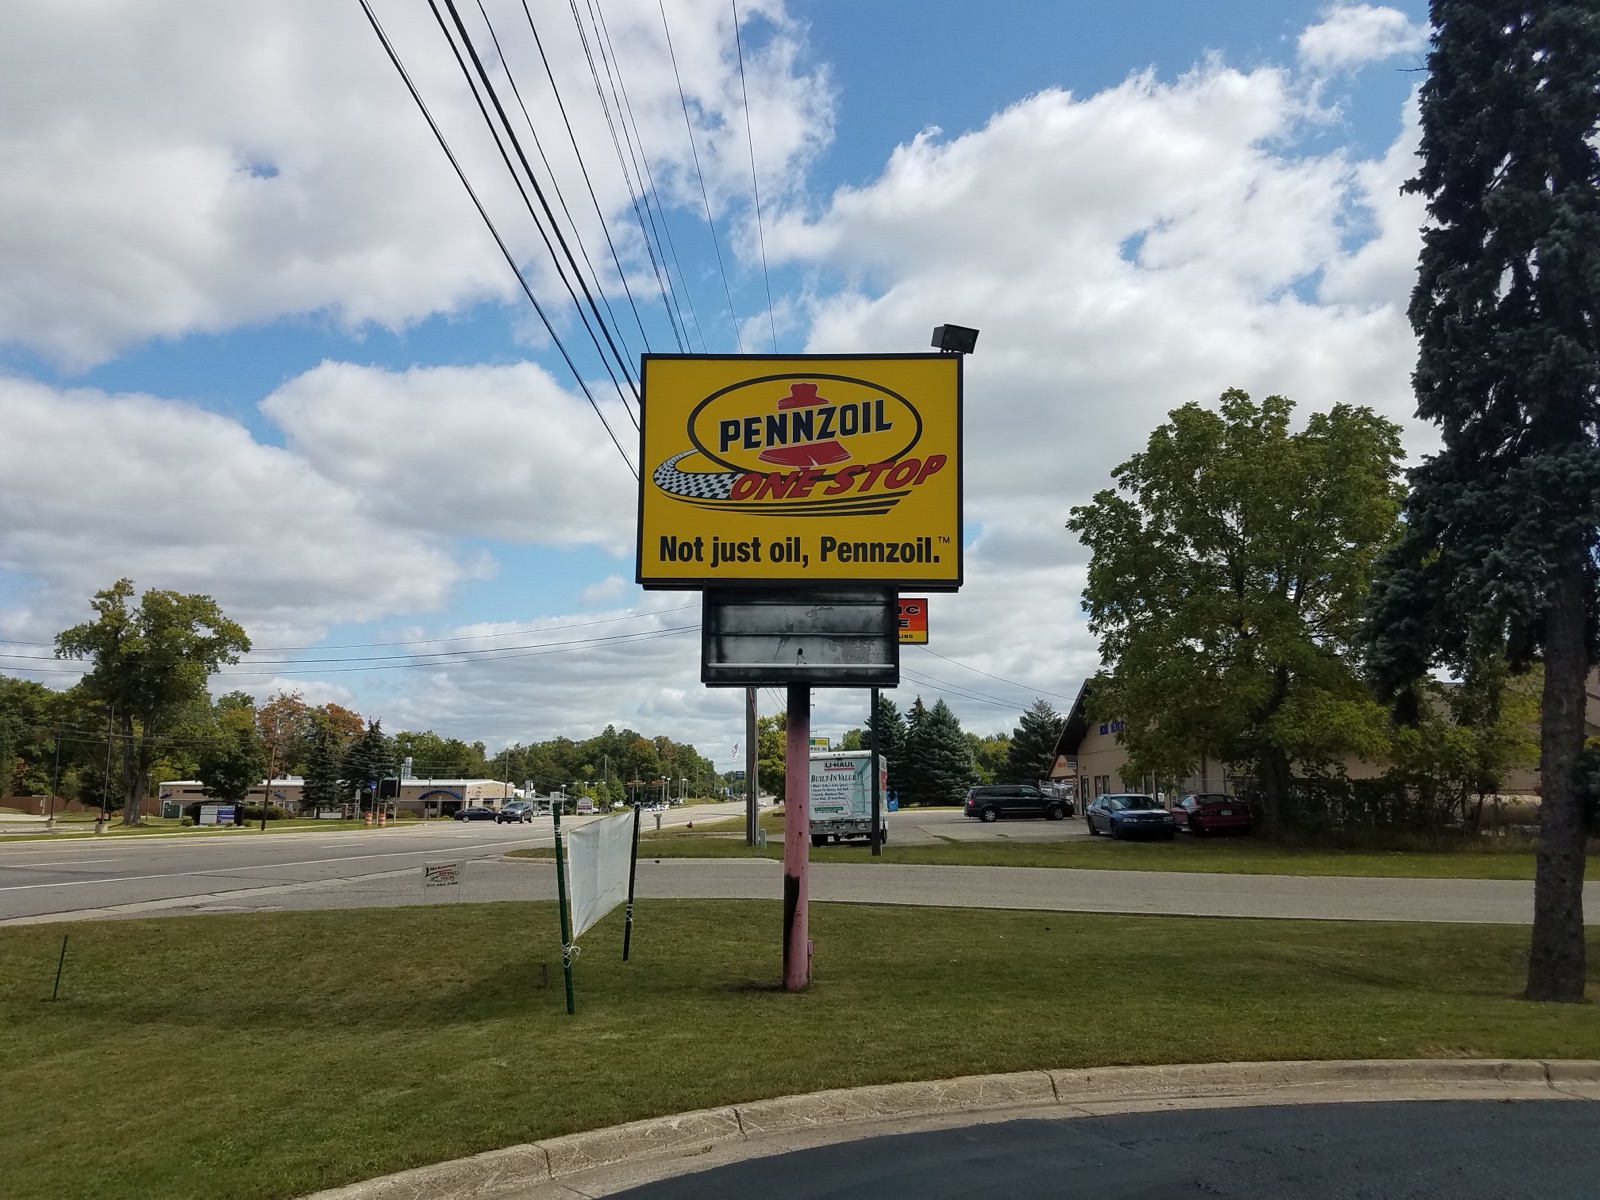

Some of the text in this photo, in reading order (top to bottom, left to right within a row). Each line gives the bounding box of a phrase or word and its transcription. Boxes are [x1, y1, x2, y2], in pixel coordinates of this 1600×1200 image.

[719, 399, 893, 453] PENNZOIL
[730, 454, 947, 501] ONE STOP
[659, 535, 704, 562] Not
[710, 535, 761, 568] just
[769, 536, 809, 568] oil,
[820, 536, 940, 563] Pennzoil.
